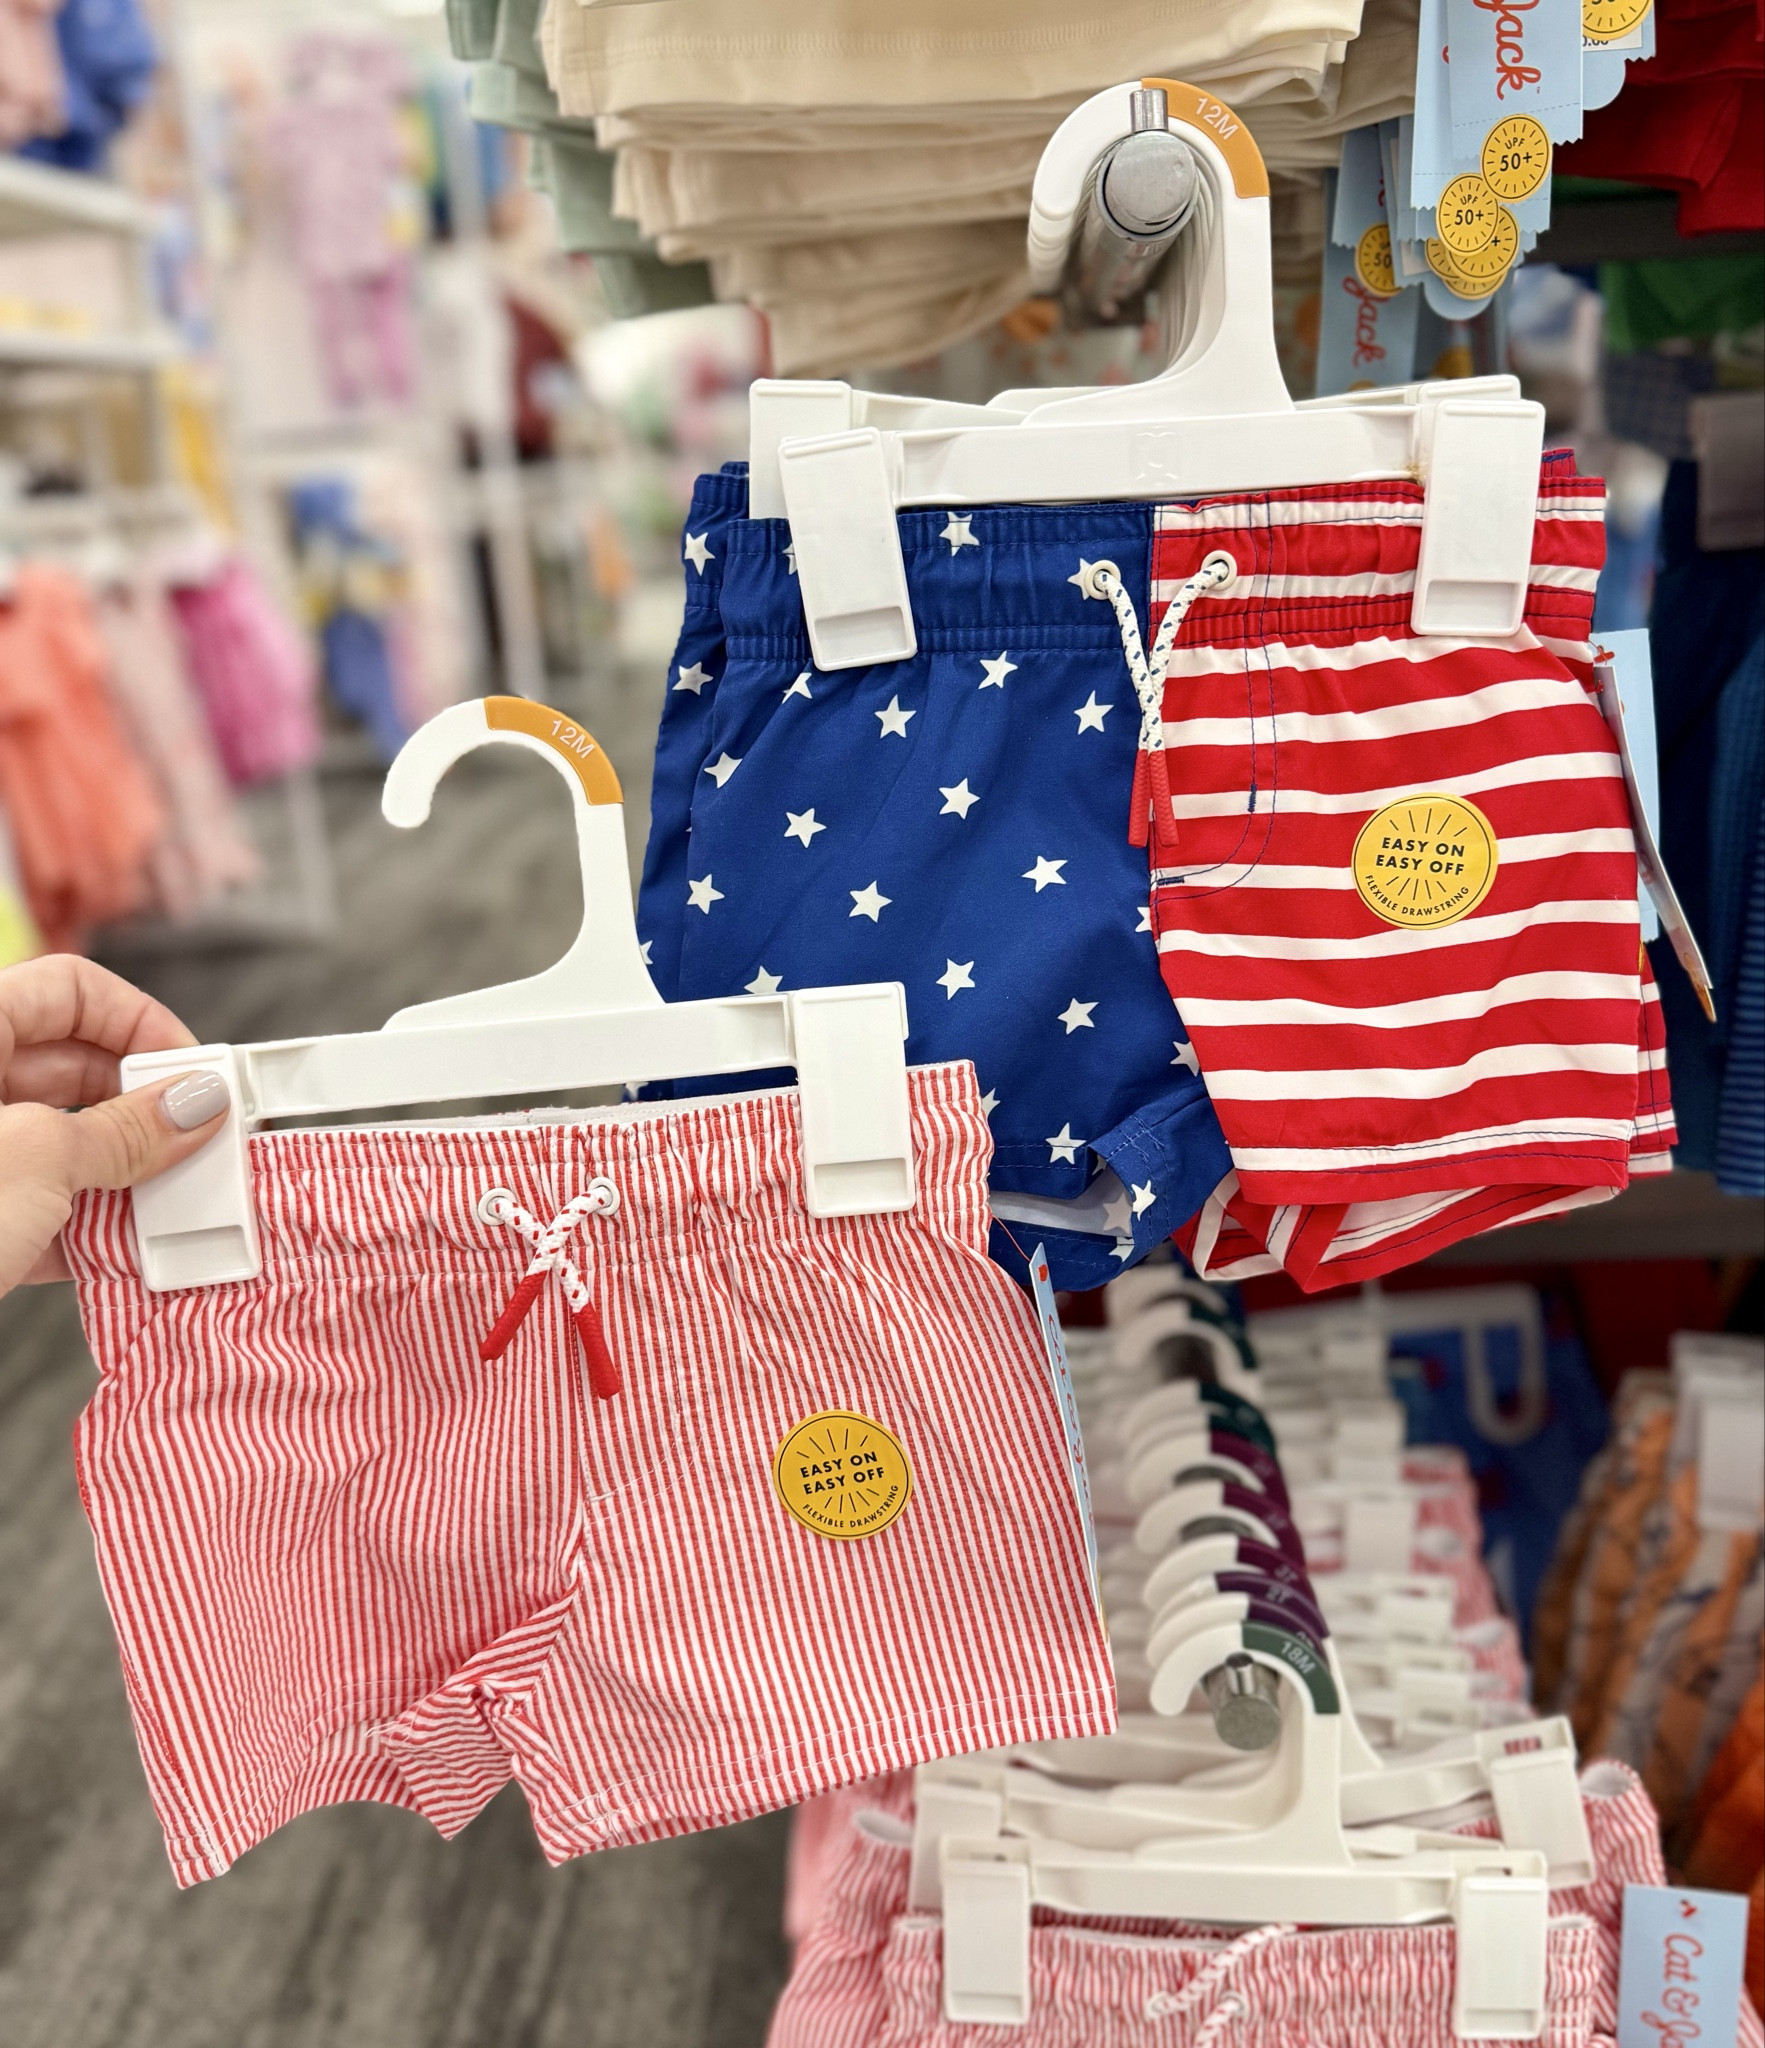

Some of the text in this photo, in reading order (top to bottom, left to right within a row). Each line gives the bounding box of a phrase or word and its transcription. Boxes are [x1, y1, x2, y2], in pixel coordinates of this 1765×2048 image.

[1196, 97, 1239, 140] 12M
[1504, 136, 1525, 150] UPF
[1500, 152, 1532, 172] 50+
[1460, 194, 1477, 205] UPF
[1454, 209, 1484, 226] 50+
[551, 719, 595, 759] 12M
[1381, 837, 1465, 857] EASY ON
[1376, 854, 1465, 876] EASY OFF
[1365, 874, 1469, 916] FLEXIBLE DRAWSTRING
[800, 1451, 877, 1478] EASY ON
[803, 1467, 885, 1495] EASY OFF
[803, 1484, 899, 1528] FLEXIBLE DRAWSTRING
[1281, 1641, 1316, 1675] 18M
[1664, 1933, 1704, 1982] Cat
[1661, 1986, 1700, 2018] &
